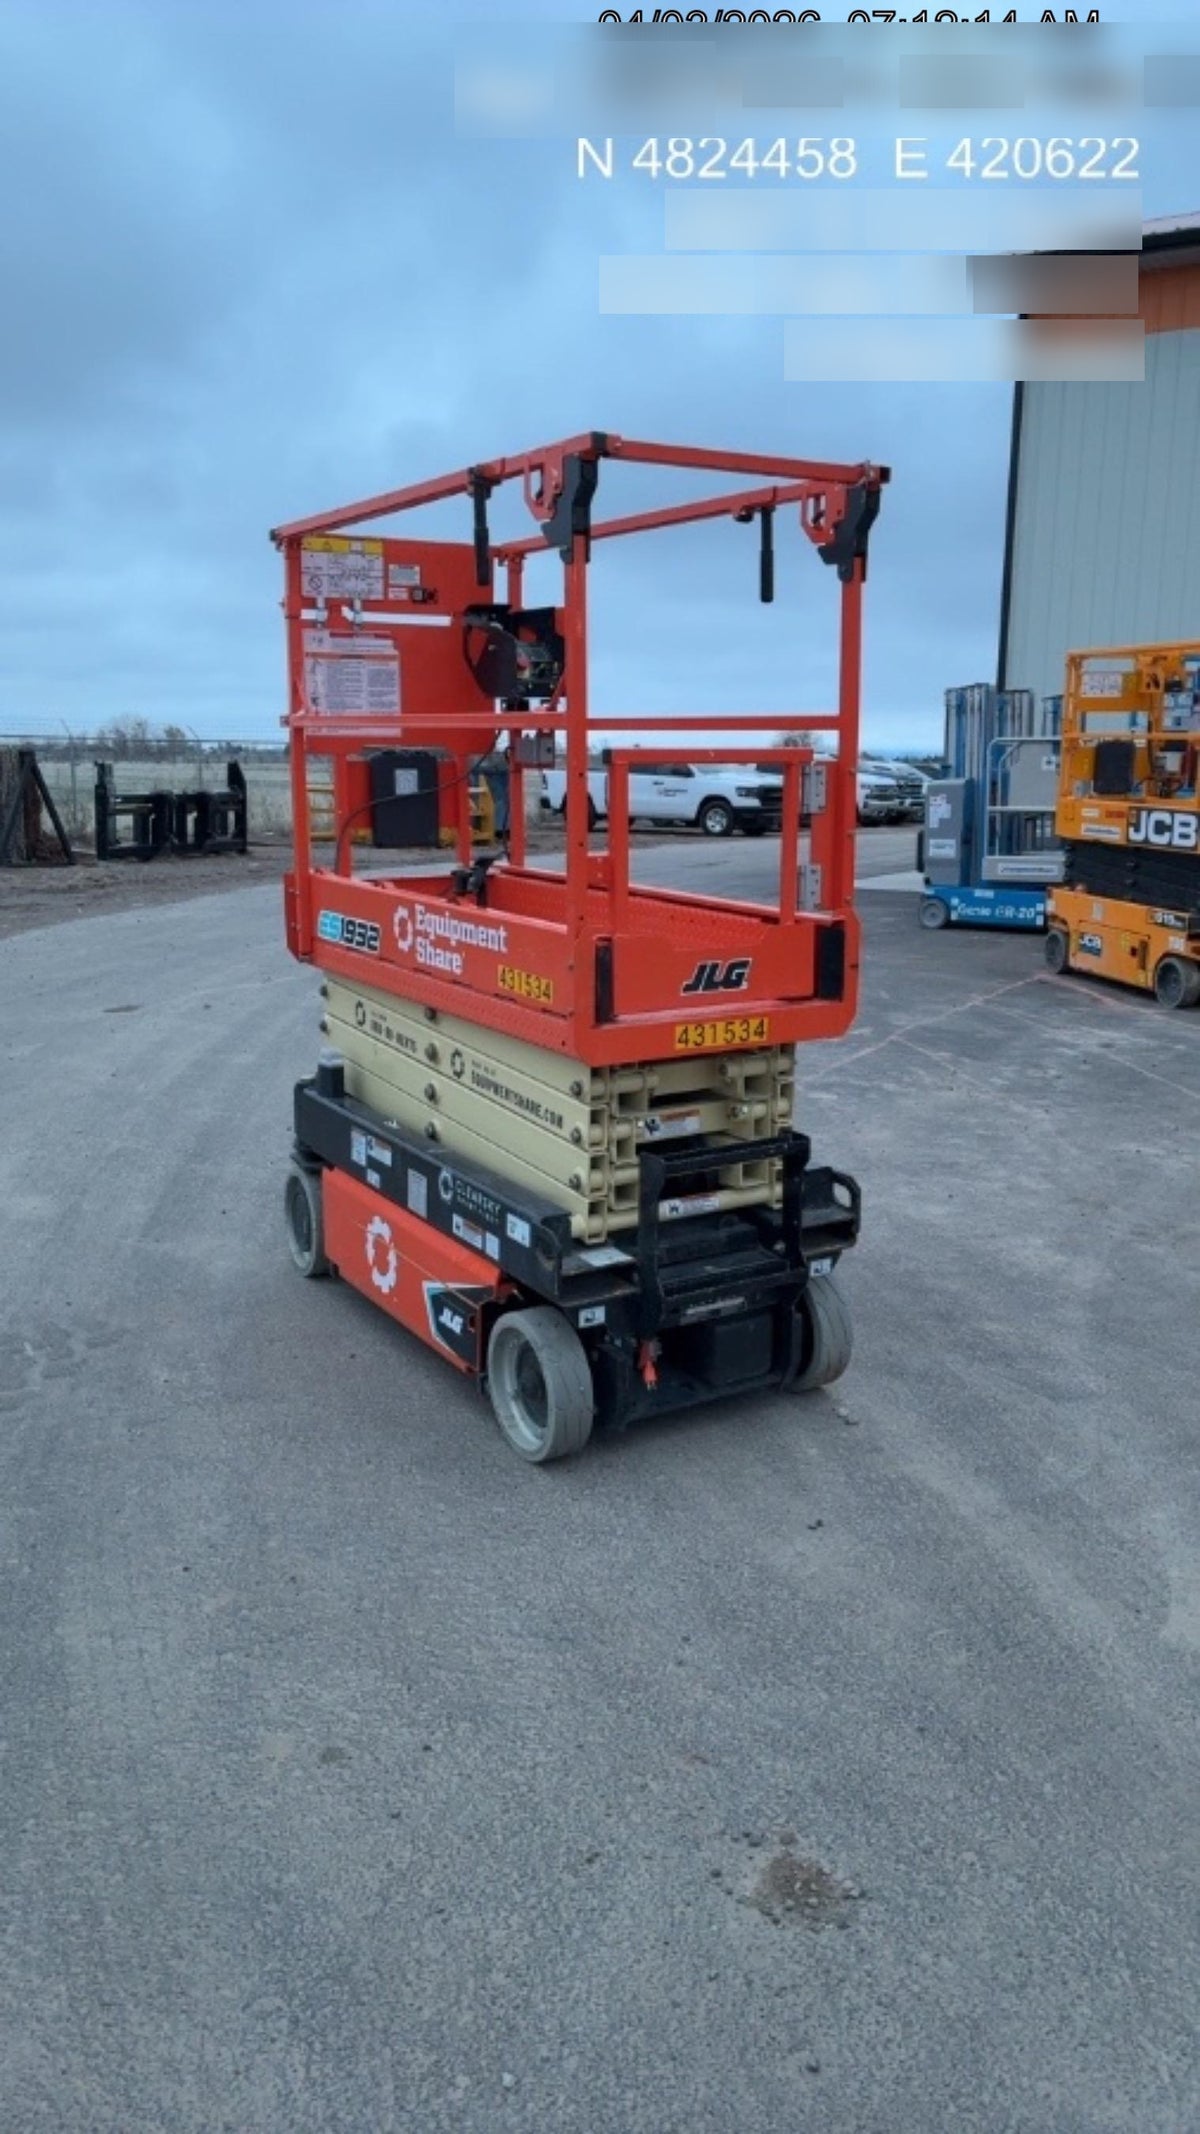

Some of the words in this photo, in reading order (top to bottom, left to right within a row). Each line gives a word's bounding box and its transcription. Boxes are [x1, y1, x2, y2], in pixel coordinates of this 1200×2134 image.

[1128, 810, 1197, 847] JCB
[318, 910, 381, 953] ES1932
[415, 903, 508, 953] Equipment
[416, 936, 463, 975] Share
[499, 966, 552, 1001] 431534
[681, 958, 752, 996] JLG
[677, 1018, 766, 1047] 431534
